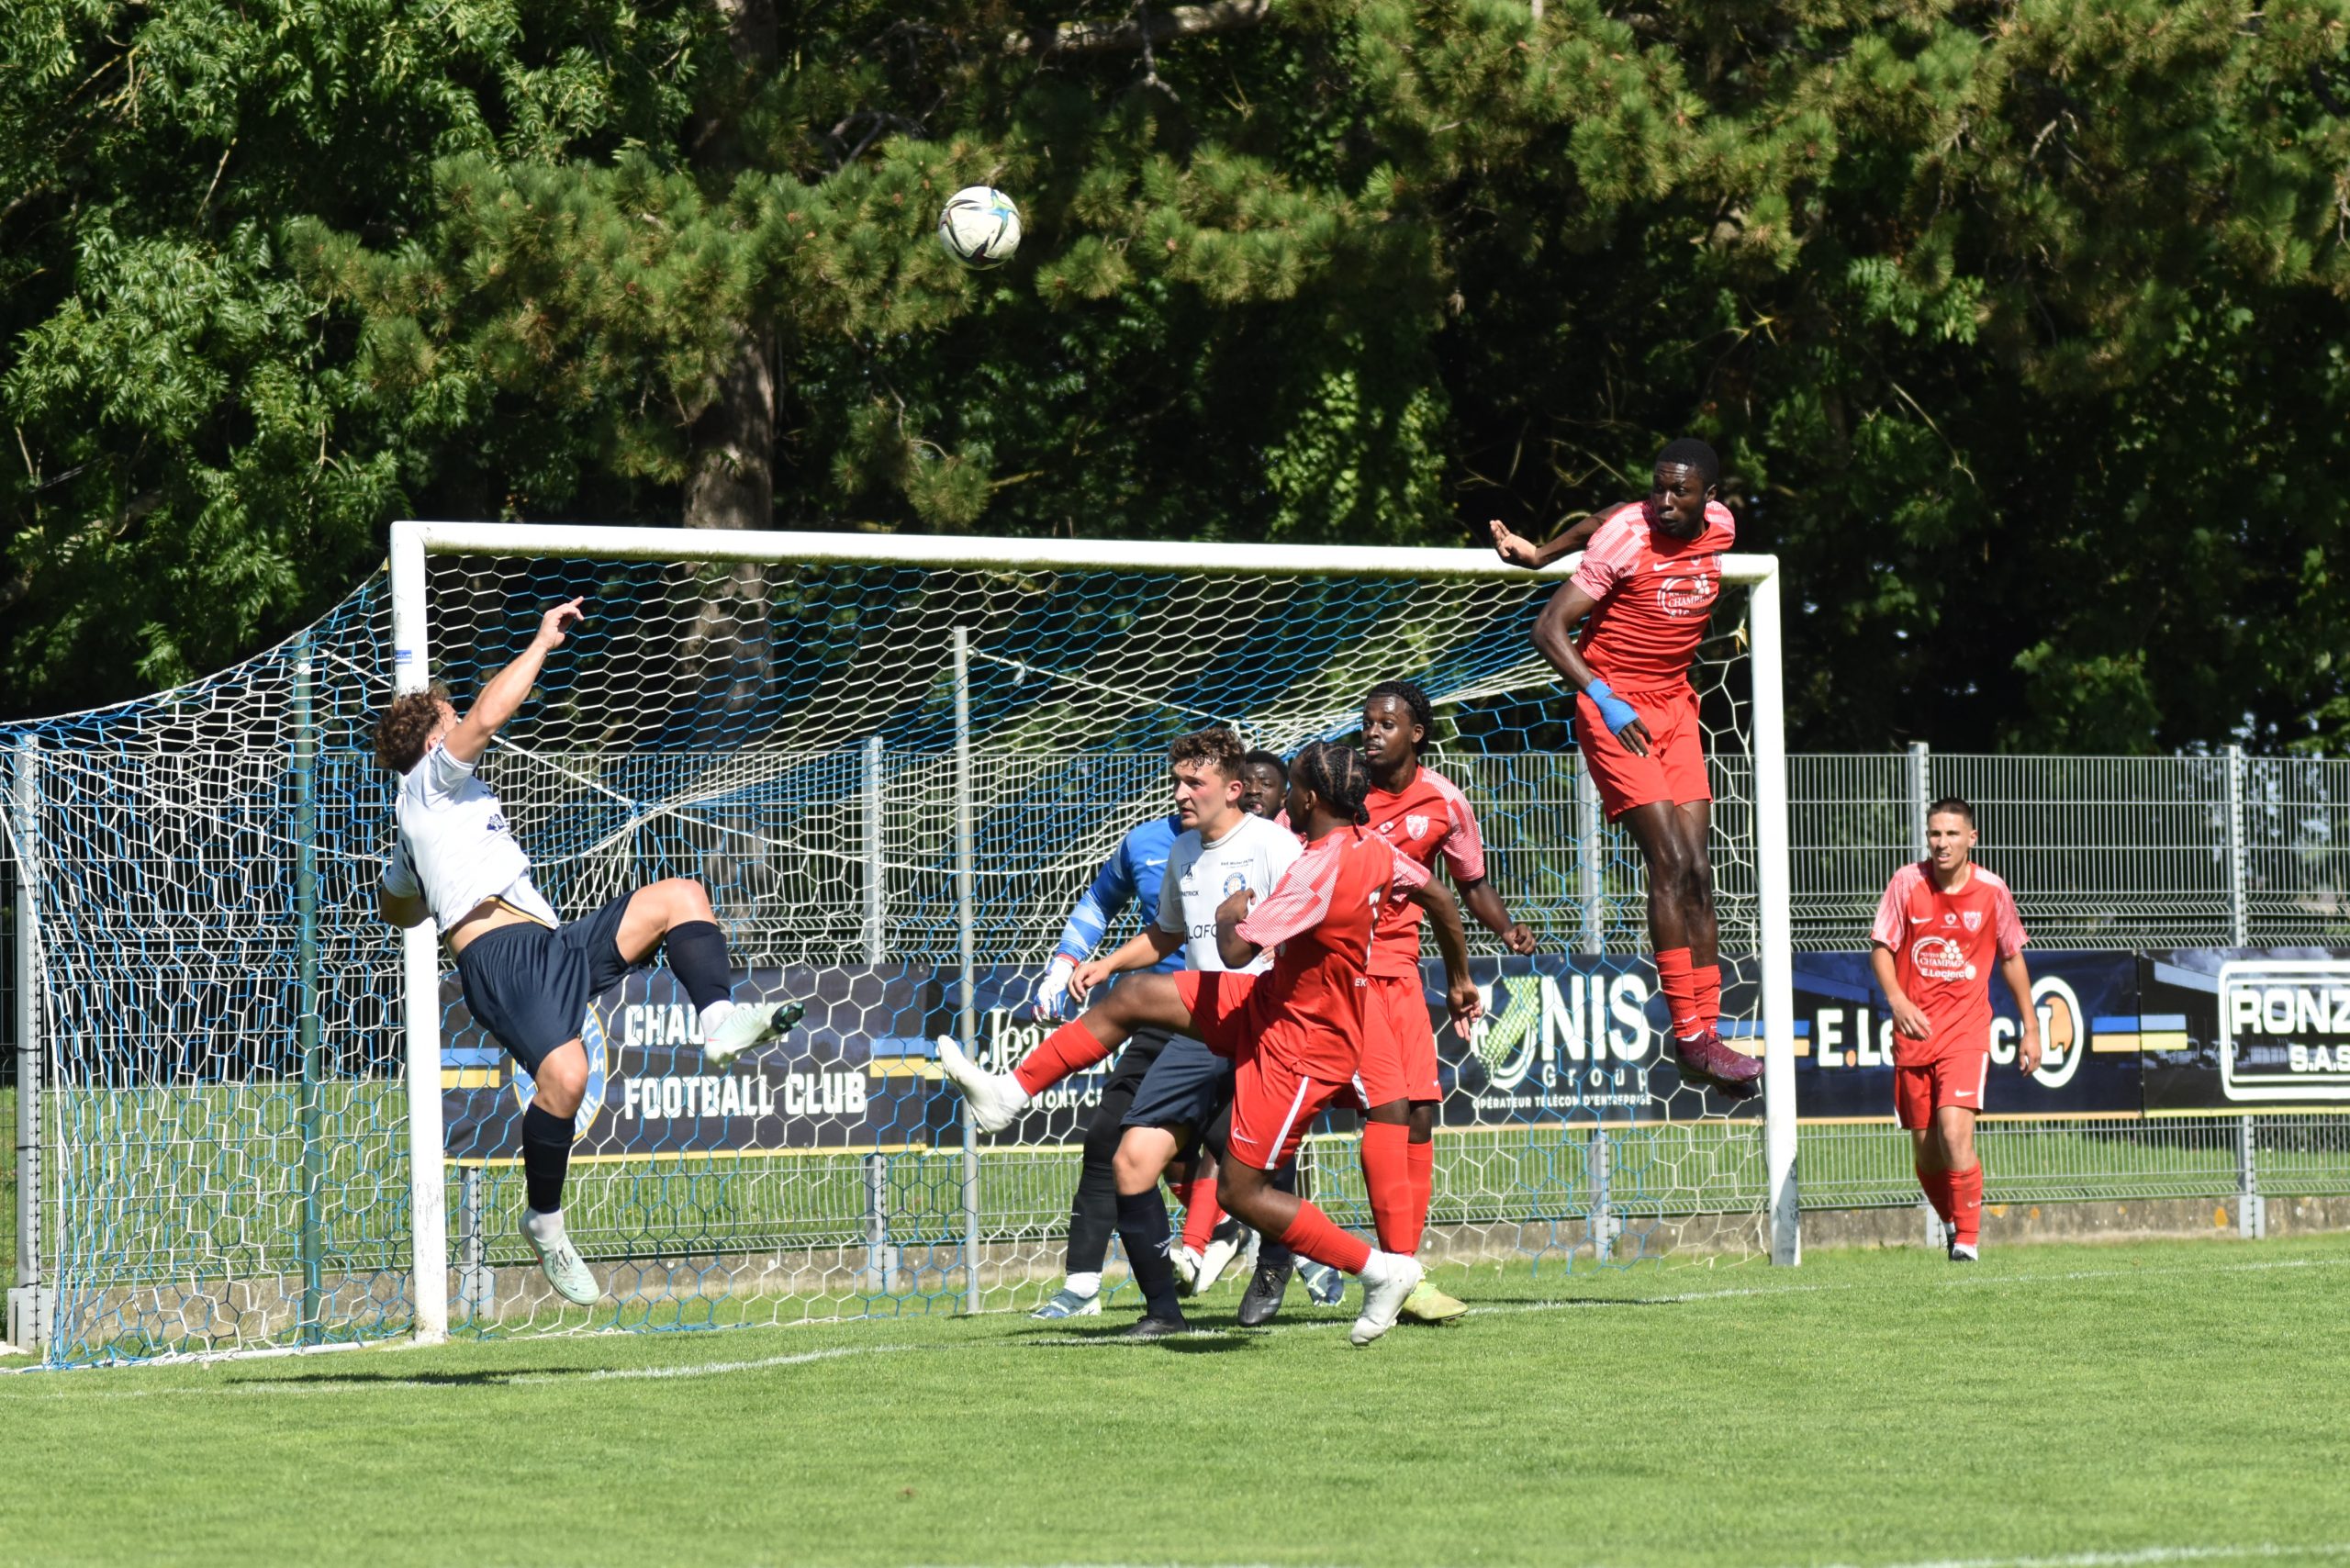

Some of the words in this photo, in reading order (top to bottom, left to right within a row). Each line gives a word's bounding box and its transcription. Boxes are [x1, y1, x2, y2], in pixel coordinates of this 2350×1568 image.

[1542, 1062, 1649, 1092] Group
[624, 1074, 774, 1120] FOOTBALL
[785, 1071, 867, 1114] CLUB
[1472, 1095, 1531, 1109] OPÉRATEUR
[1535, 1093, 1579, 1107] TÉLÉCOM
[1583, 1093, 1652, 1106] D'ENTREPRISE
